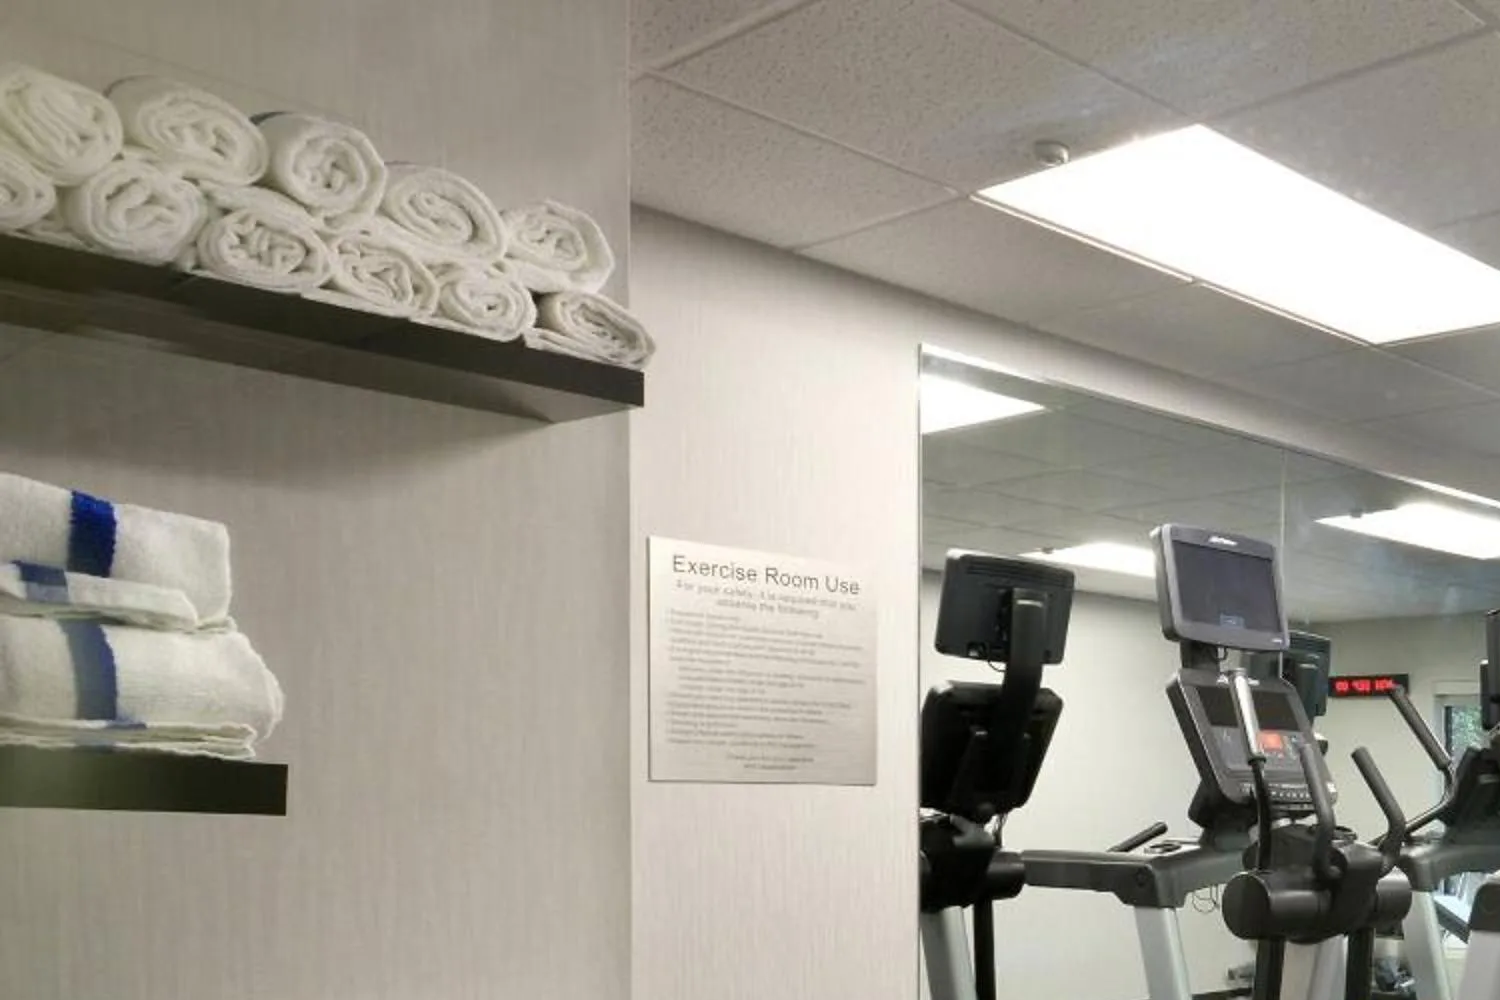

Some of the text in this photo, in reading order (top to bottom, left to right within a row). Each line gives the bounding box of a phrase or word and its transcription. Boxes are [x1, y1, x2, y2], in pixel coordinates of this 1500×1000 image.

[673, 555, 860, 595] Exercise Room Use
